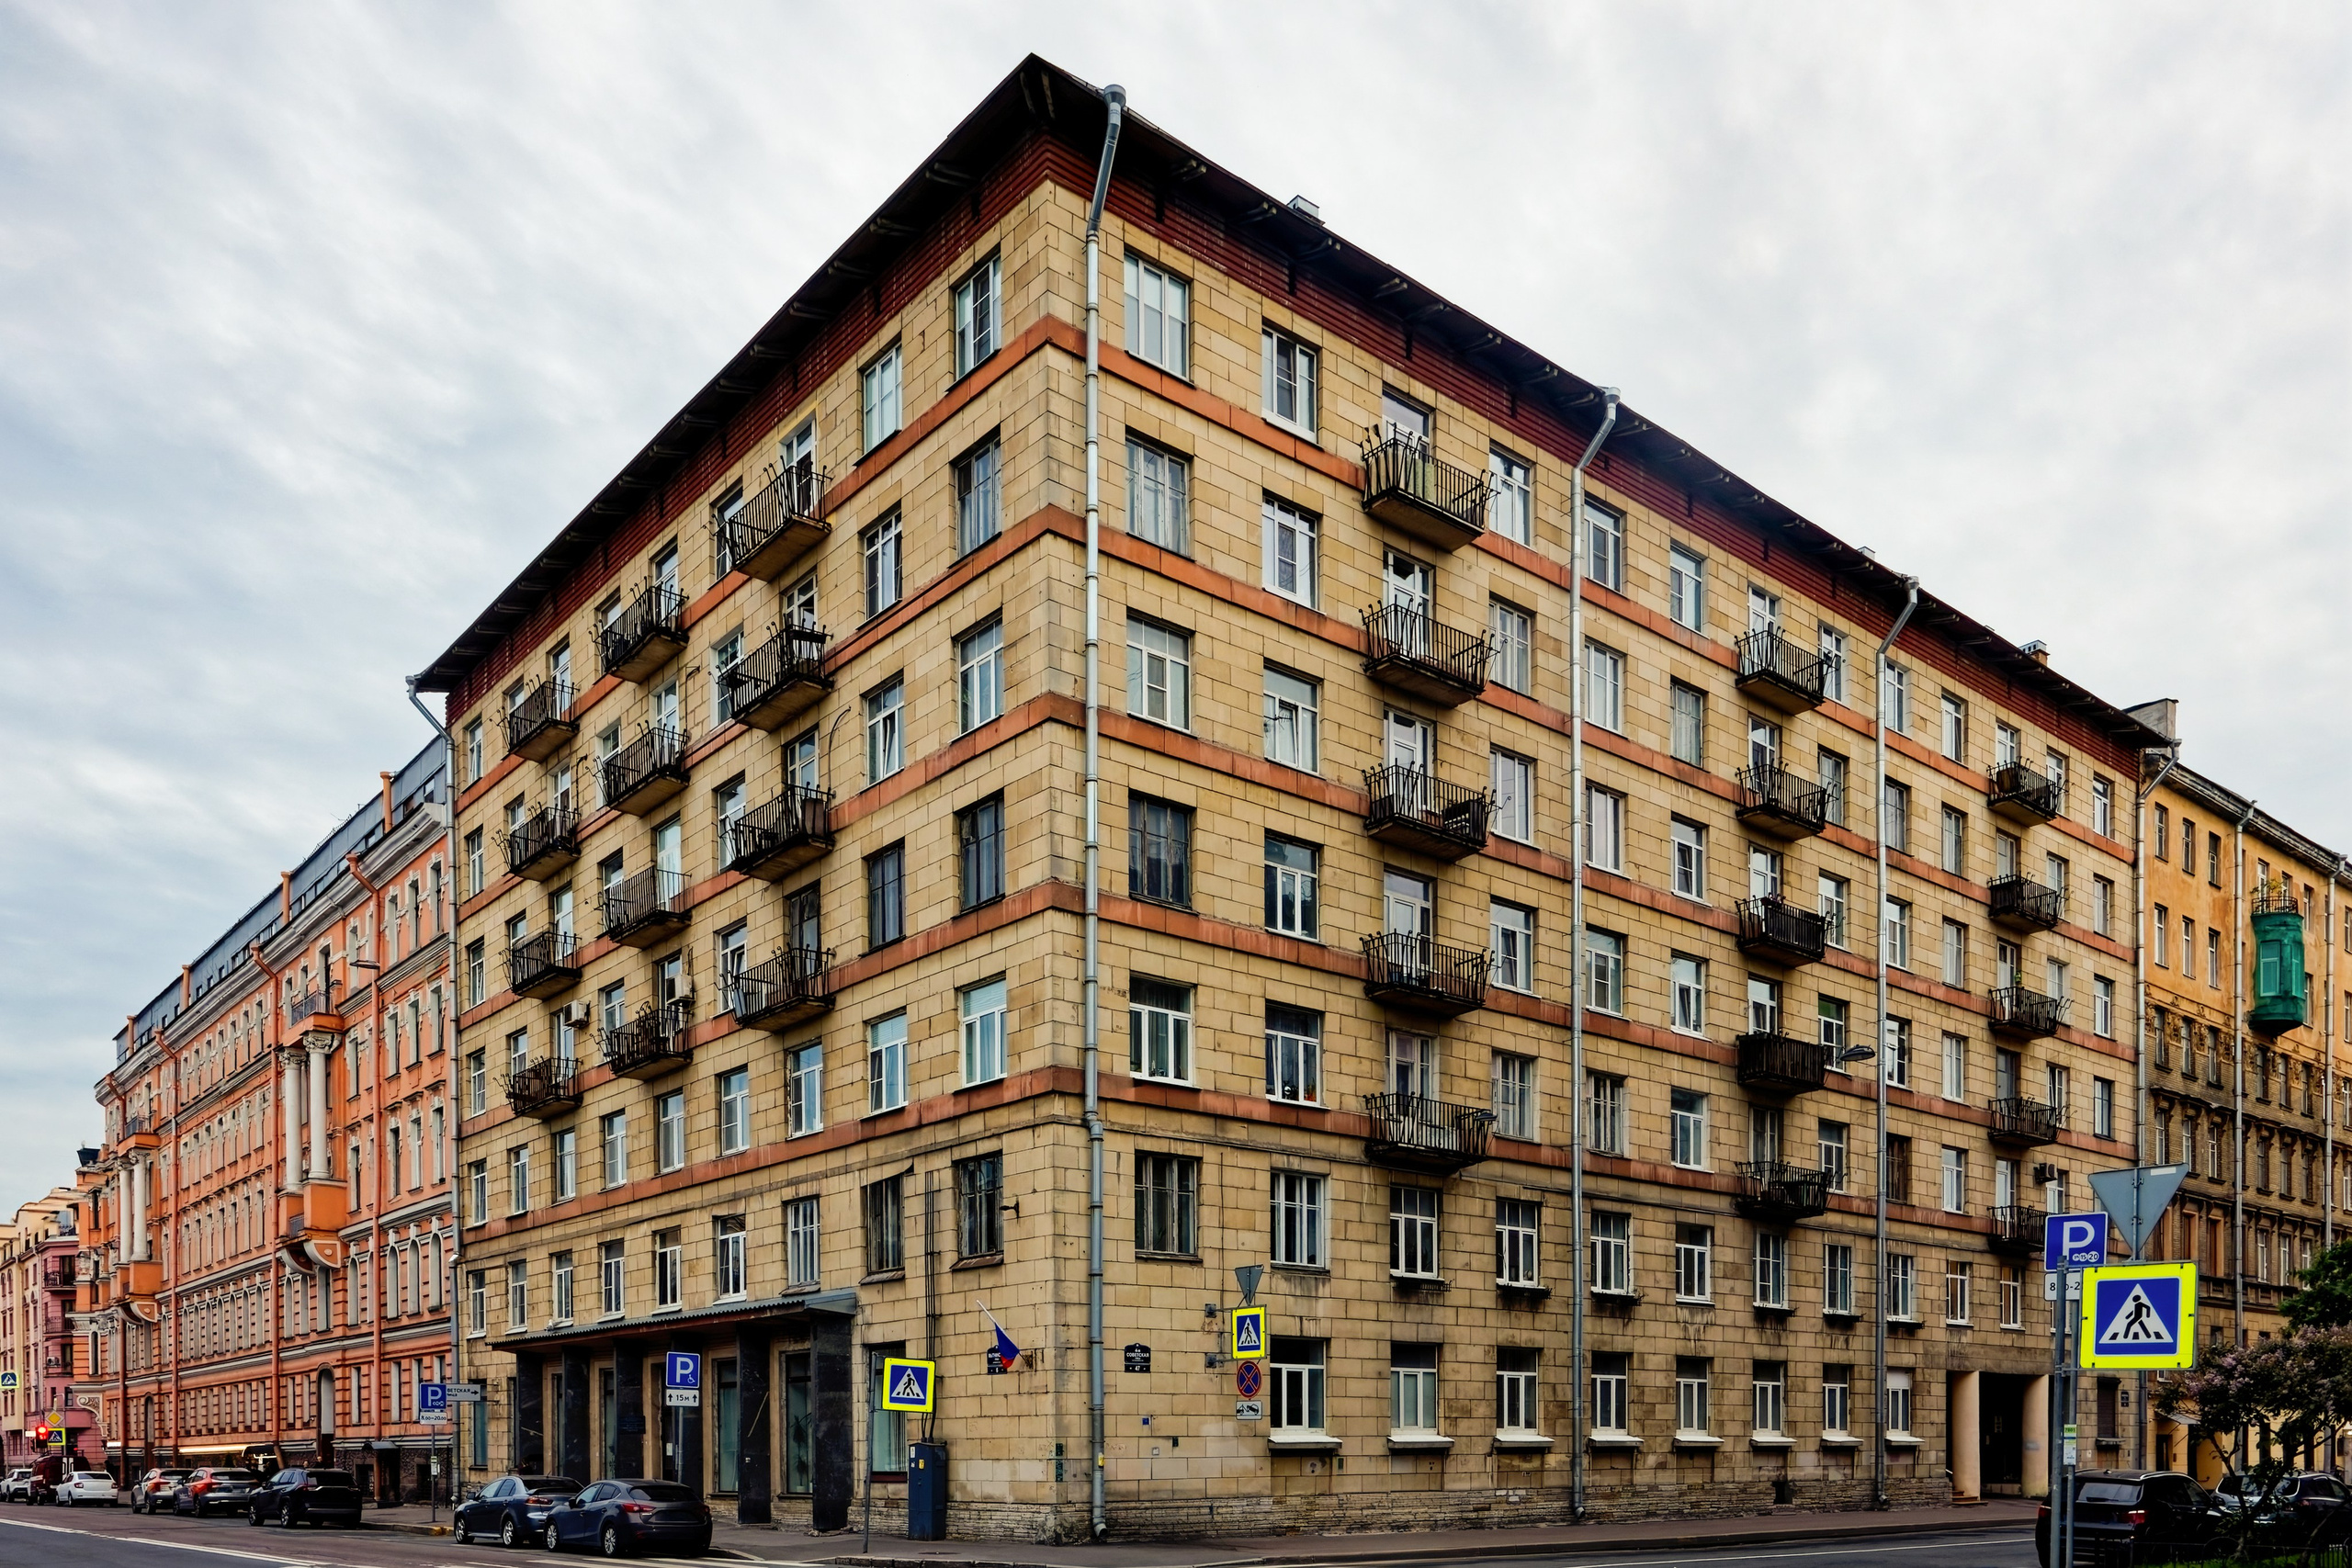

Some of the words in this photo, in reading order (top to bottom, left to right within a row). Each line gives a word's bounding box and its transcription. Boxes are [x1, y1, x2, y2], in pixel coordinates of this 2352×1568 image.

[2063, 1221, 2095, 1260] P
[676, 1357, 694, 1383] P
[427, 1386, 442, 1406] P
